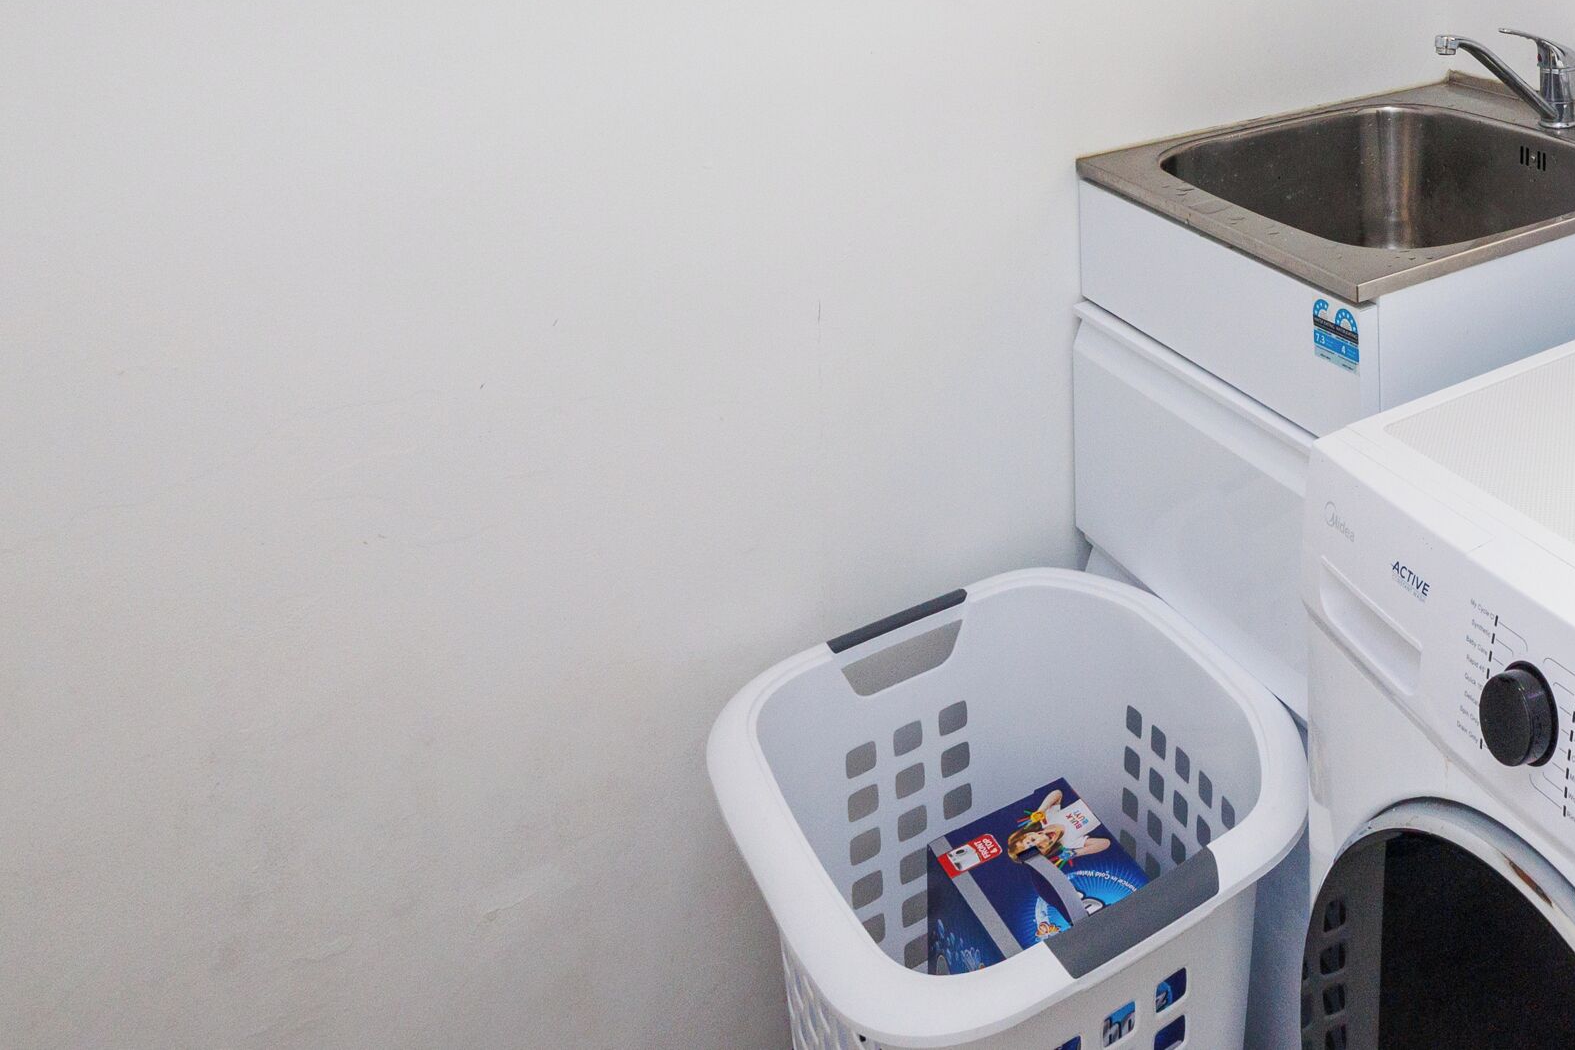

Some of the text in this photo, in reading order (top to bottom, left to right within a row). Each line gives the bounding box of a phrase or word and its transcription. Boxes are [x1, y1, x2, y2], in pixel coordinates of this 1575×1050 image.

[1325, 501, 1354, 542] Midea
[1392, 561, 1430, 596] ACTIVE
[974, 841, 991, 859] FRONT
[982, 838, 994, 850] TOP
[1095, 871, 1110, 880] Cold
